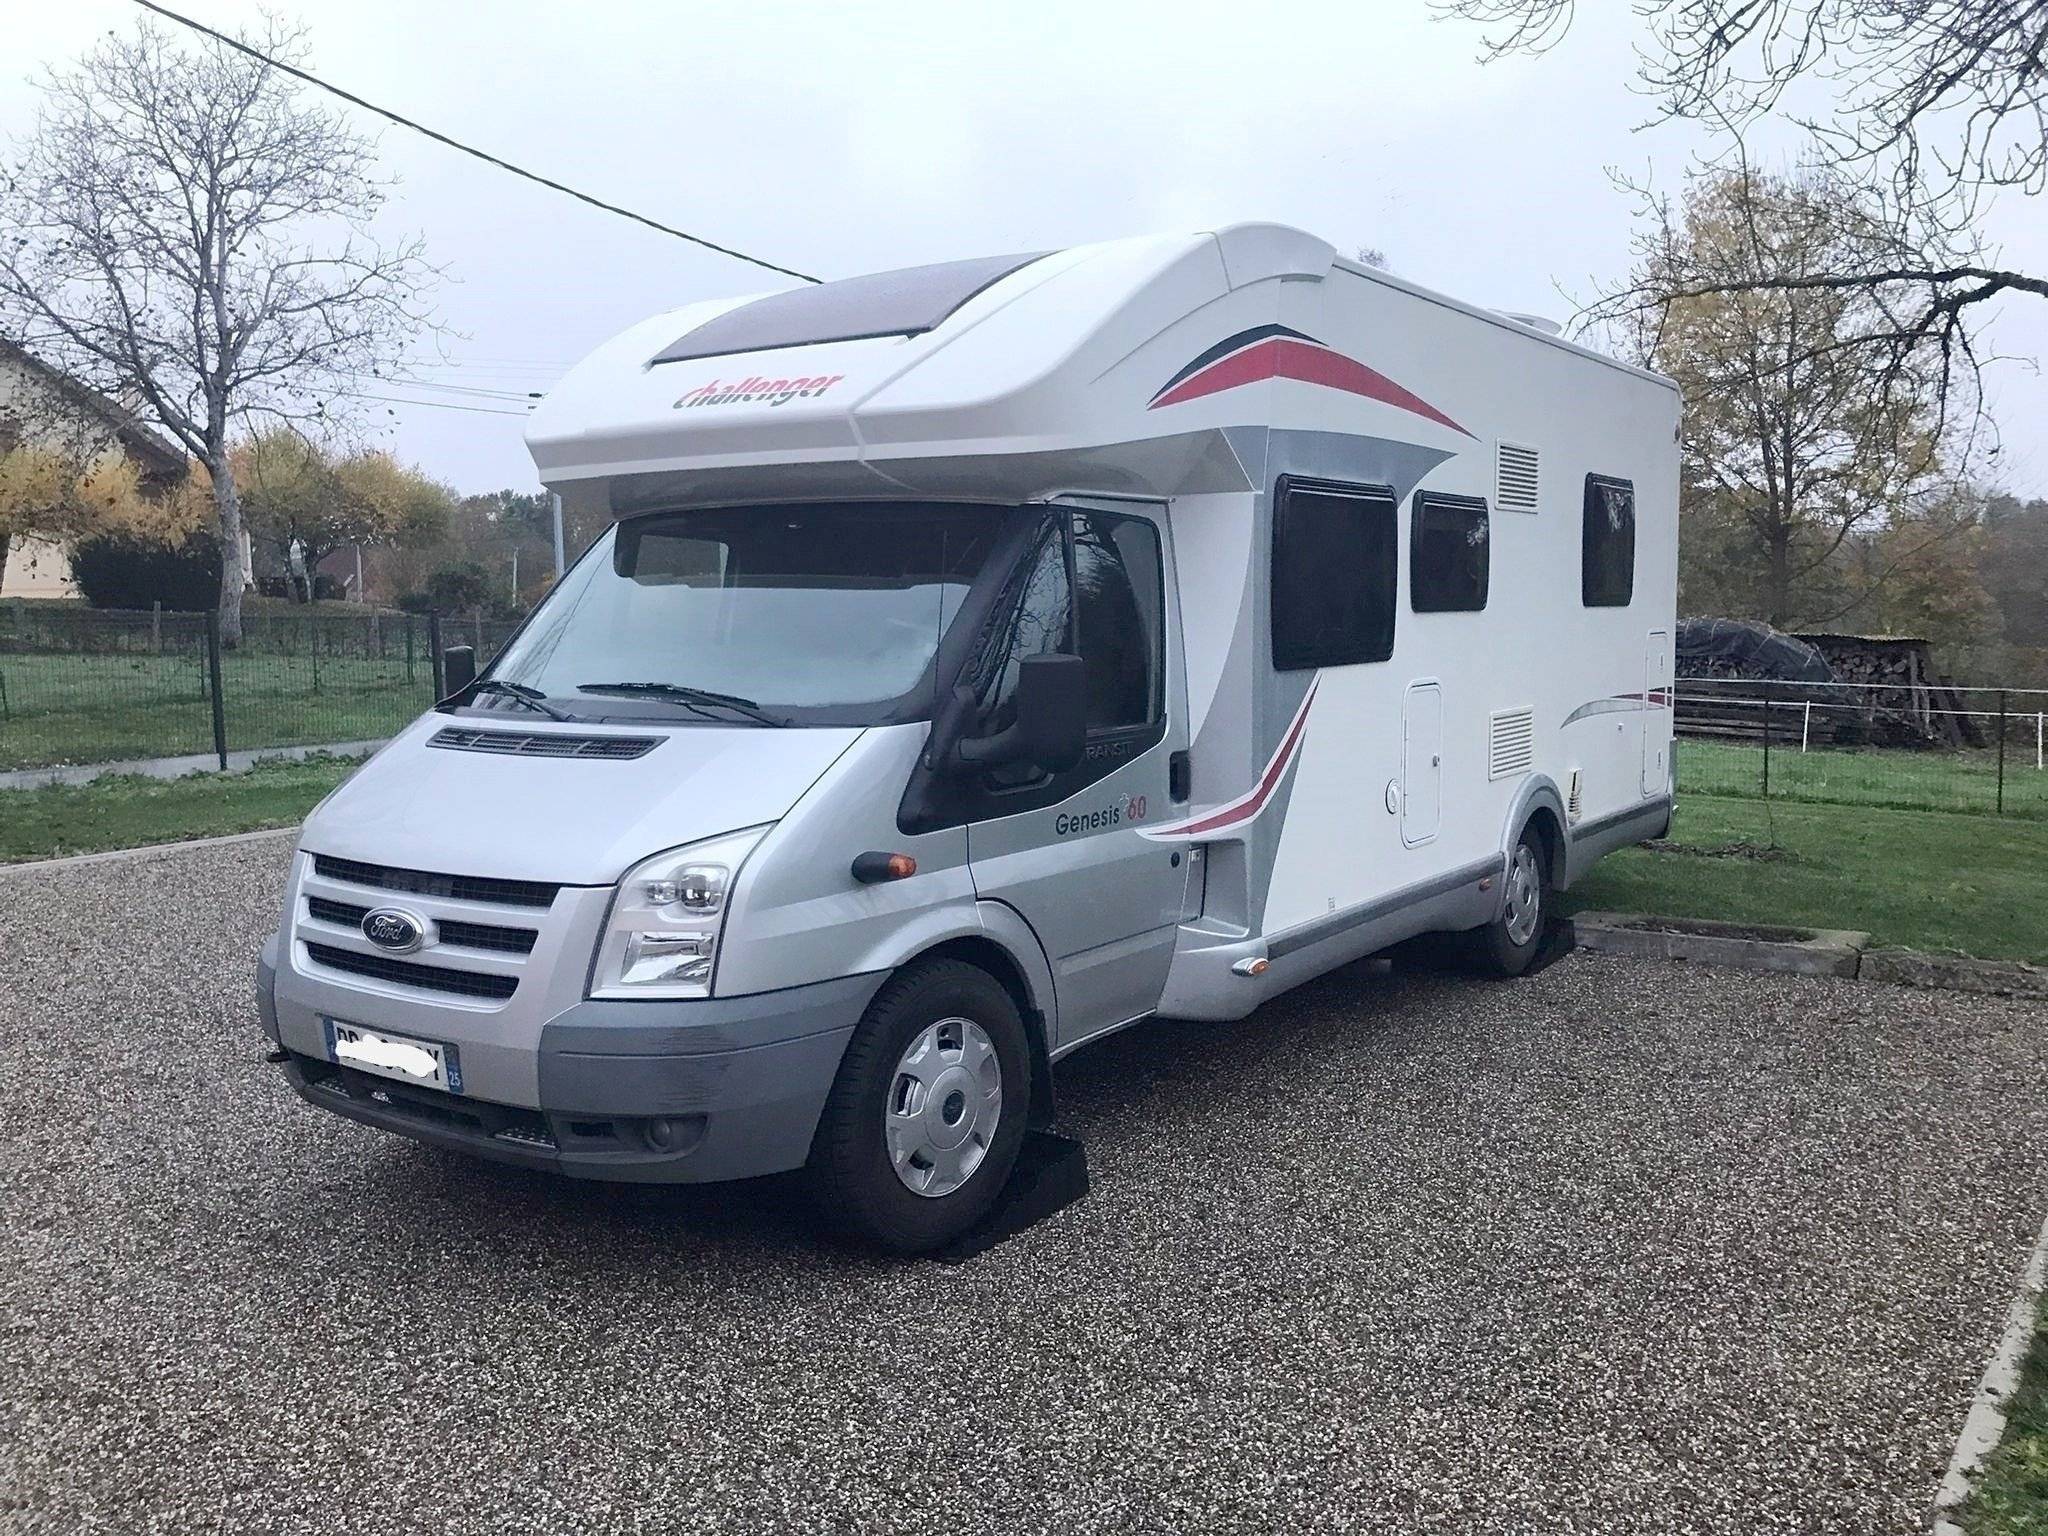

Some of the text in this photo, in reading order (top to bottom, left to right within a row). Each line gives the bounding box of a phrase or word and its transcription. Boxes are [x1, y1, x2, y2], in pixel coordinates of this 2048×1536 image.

[1083, 741, 1136, 760] RANSIT
[1055, 795, 1147, 836] Genesis 60
[370, 915, 404, 941] Ford
[449, 1071, 462, 1087] 25
